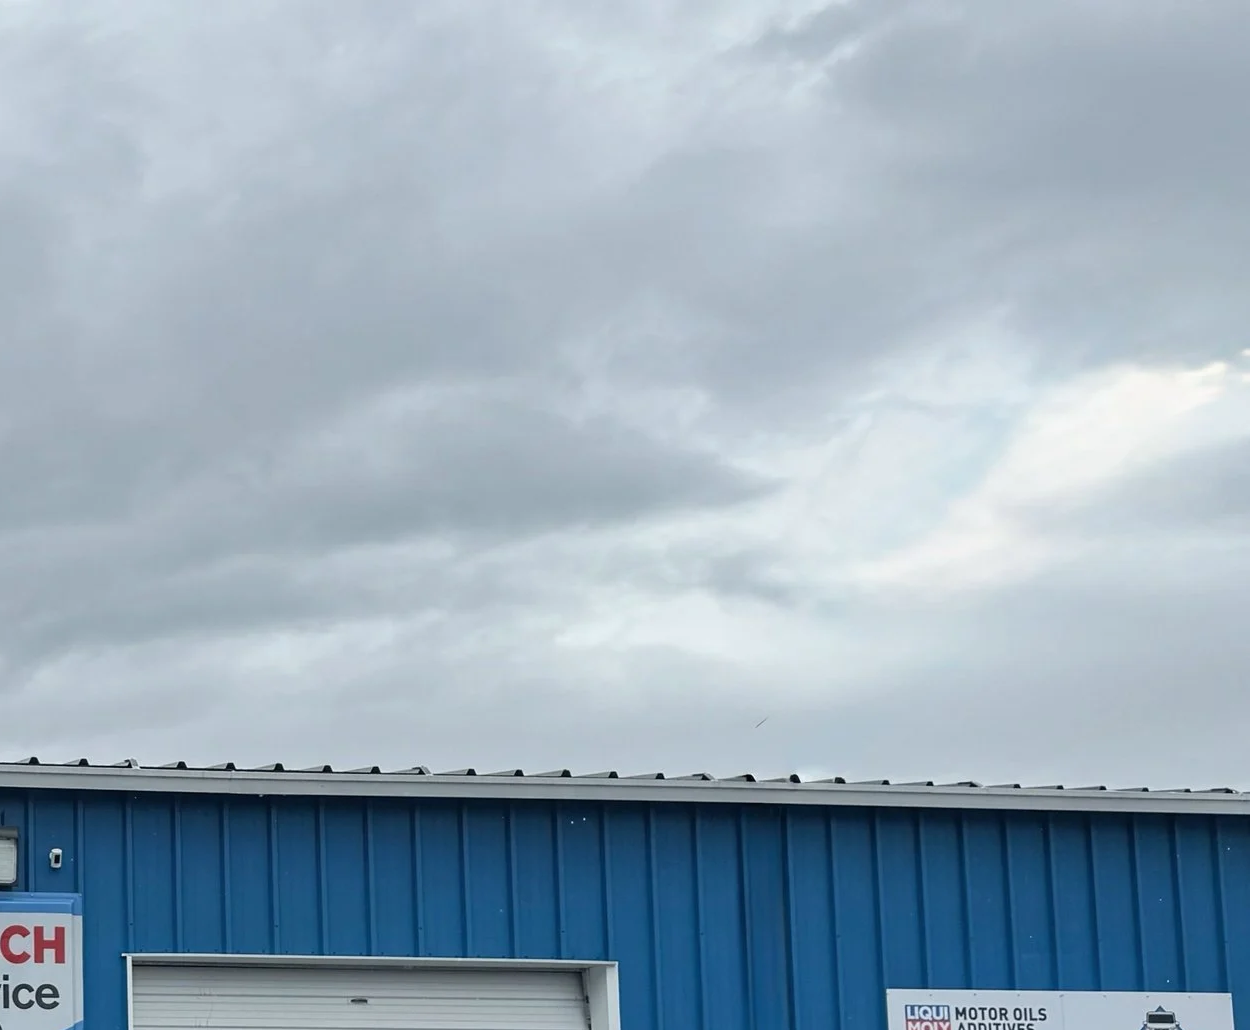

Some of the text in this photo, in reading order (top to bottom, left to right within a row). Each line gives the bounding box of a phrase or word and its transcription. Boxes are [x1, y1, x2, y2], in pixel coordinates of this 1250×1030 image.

[906, 1005, 949, 1020] LIQUI
[955, 1007, 1047, 1022] MOTOR OILS
